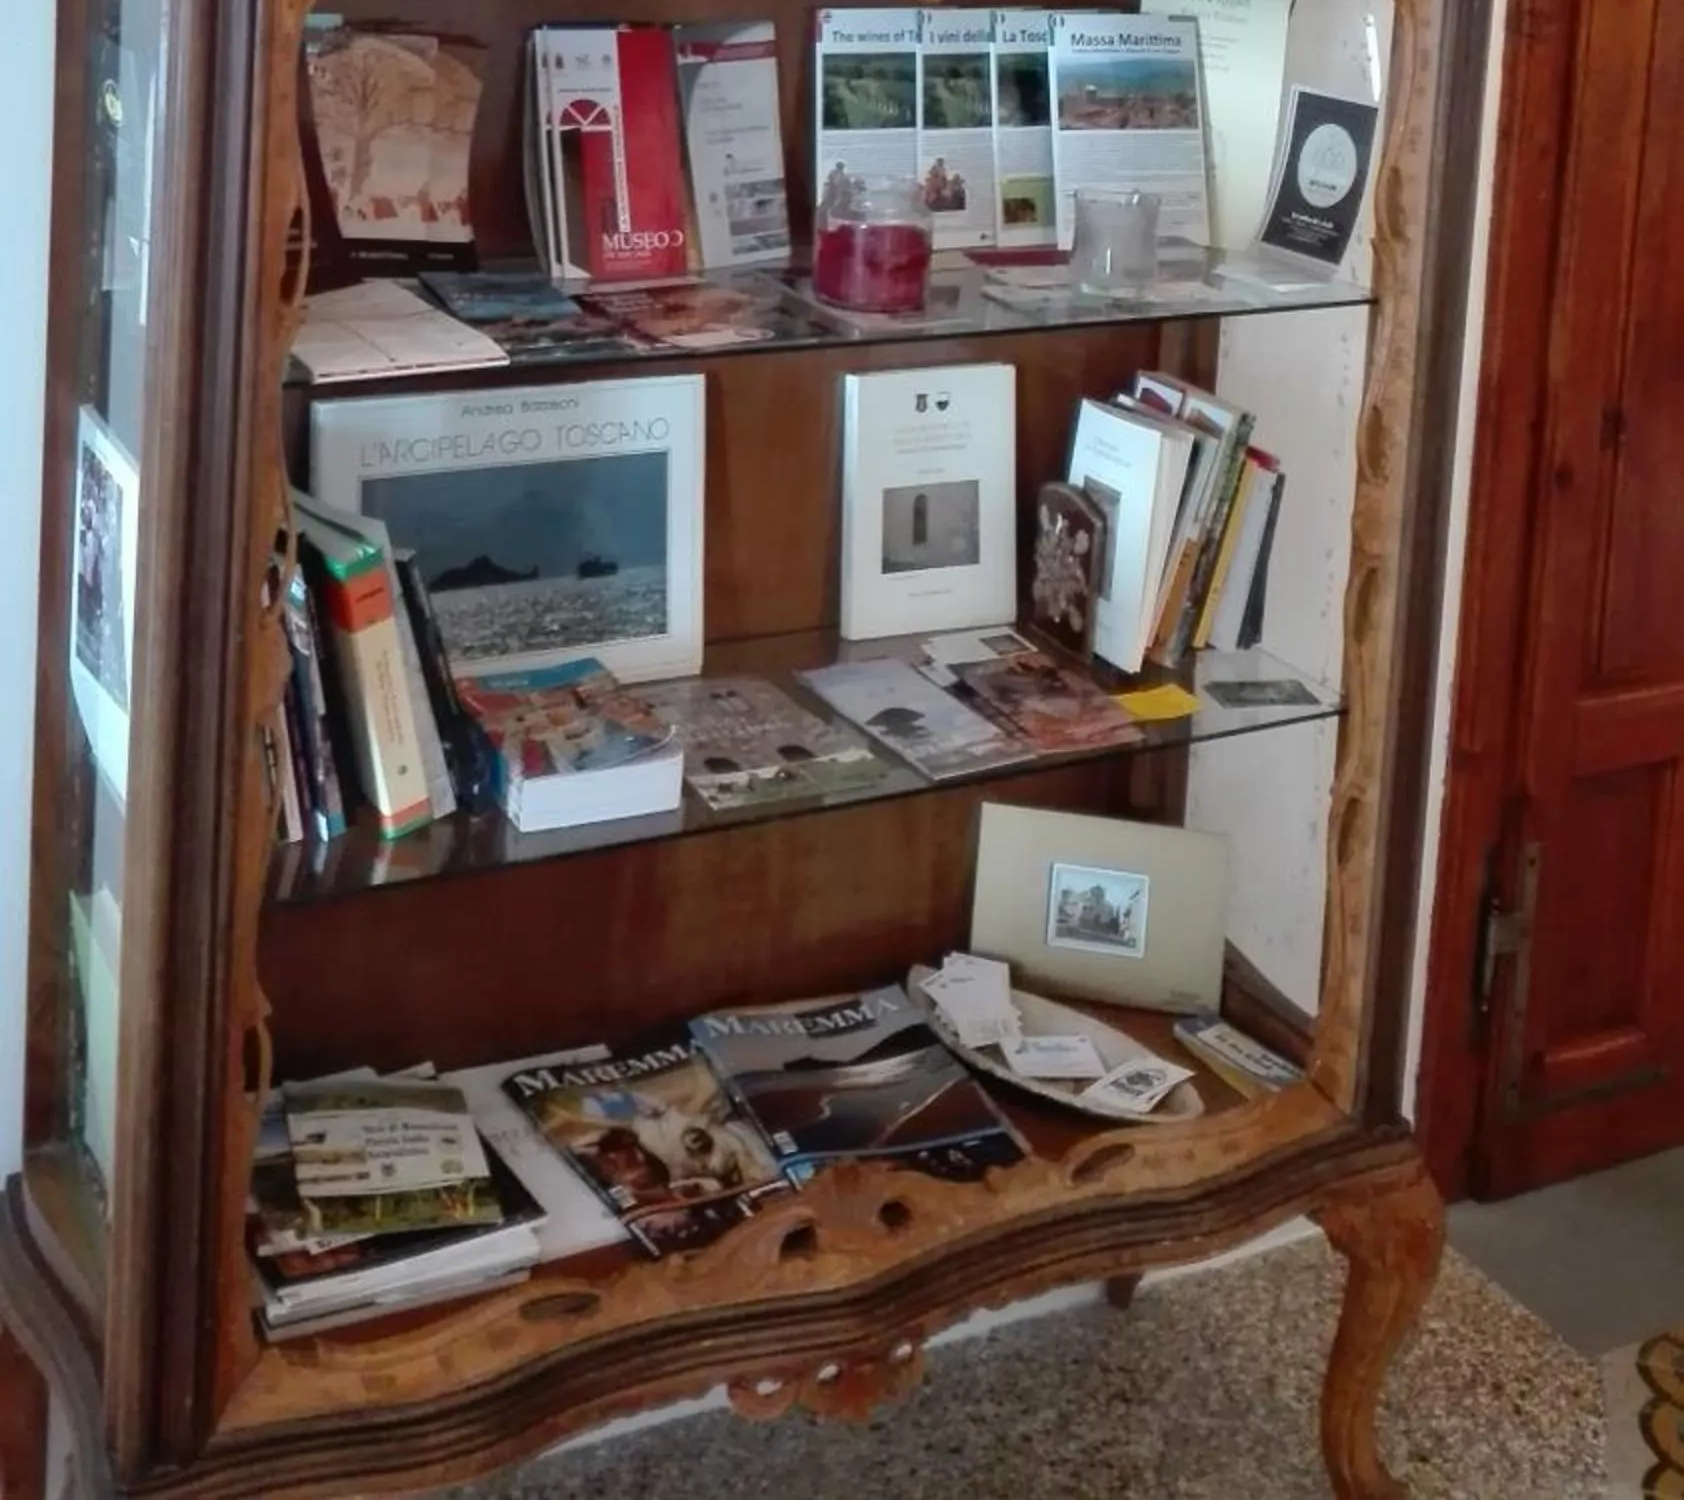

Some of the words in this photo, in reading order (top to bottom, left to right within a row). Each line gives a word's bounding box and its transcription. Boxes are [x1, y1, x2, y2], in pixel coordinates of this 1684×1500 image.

[832, 29, 855, 42] The
[1001, 29, 1017, 43] La
[1070, 32, 1115, 47] Massa
[1118, 33, 1183, 48] Marittima
[602, 231, 670, 251] MUSEO
[461, 403, 514, 418] Andrea
[359, 428, 543, 469] L'ARCIPELAGO
[554, 416, 671, 451] TOSCANO
[702, 997, 900, 1039] MAREMMA
